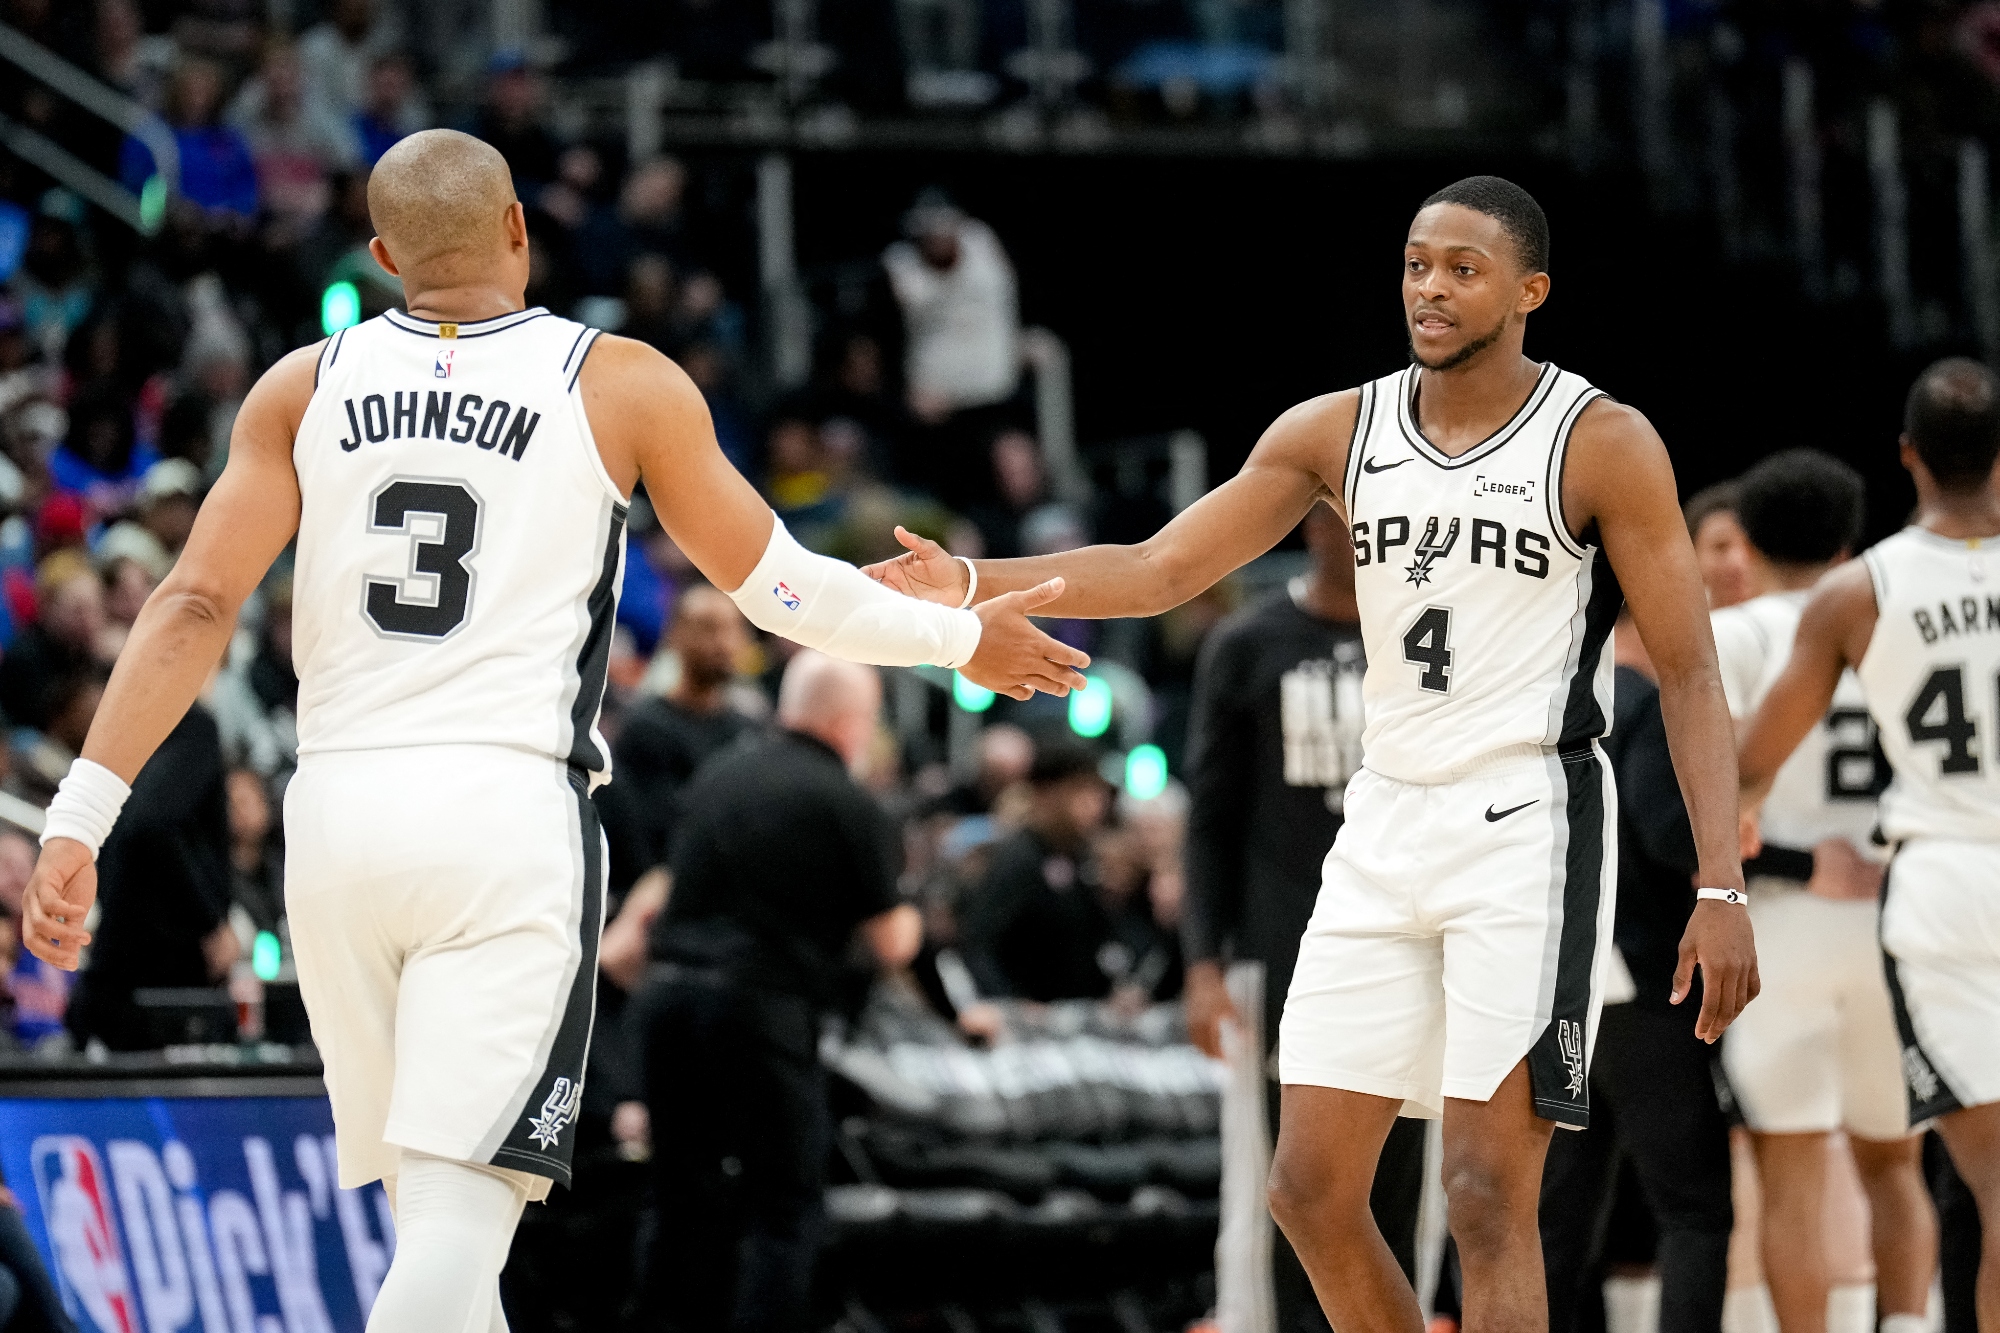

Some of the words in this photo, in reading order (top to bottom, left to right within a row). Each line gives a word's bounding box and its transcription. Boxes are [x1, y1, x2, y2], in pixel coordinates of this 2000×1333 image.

[339, 390, 541, 462] JOHNSON
[1482, 482, 1527, 496] LEDGER
[359, 473, 485, 645] 3
[1352, 515, 1551, 590] SPURS
[1400, 603, 1455, 697] 4
